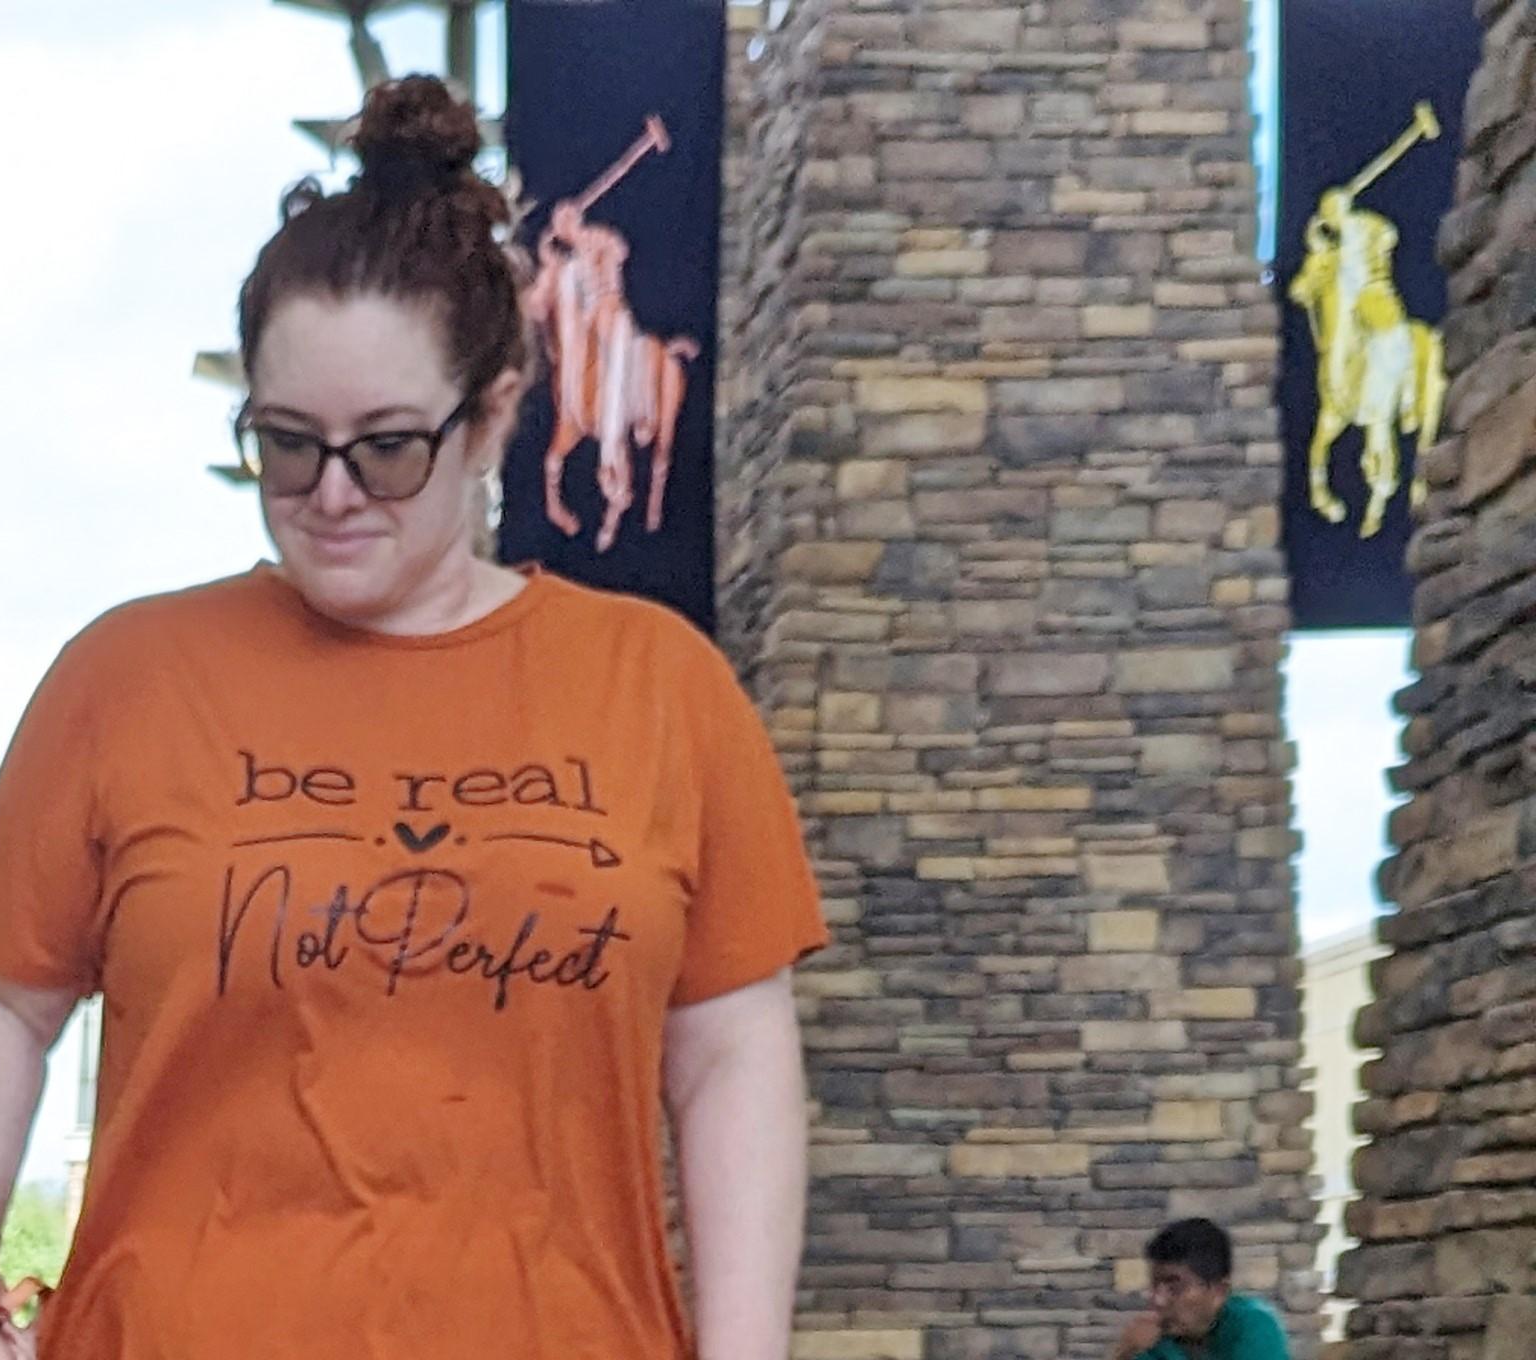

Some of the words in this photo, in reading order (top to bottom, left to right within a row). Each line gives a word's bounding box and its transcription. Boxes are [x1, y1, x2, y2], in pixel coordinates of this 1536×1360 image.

[236, 750, 356, 806] be
[393, 755, 608, 816] real
[218, 865, 366, 998] Not
[356, 868, 631, 1012] Perfect
